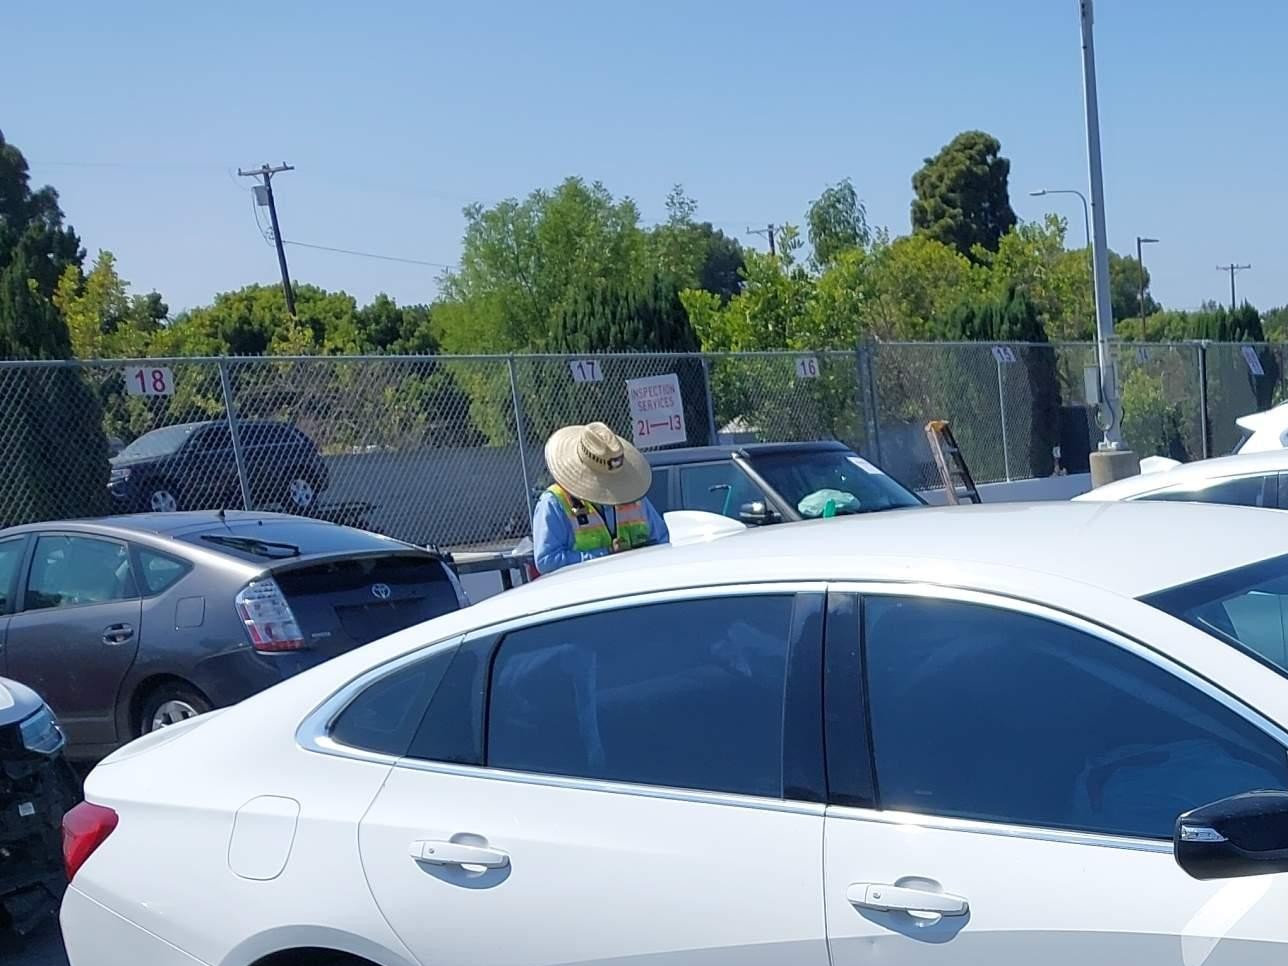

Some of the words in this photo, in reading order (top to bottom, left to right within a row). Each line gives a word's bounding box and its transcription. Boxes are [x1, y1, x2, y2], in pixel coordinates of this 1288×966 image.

[576, 361, 595, 380] 17
[800, 359, 816, 376] 16
[135, 369, 166, 393] 18
[630, 383, 676, 400] INSPECTION
[636, 396, 675, 412] SERVICES
